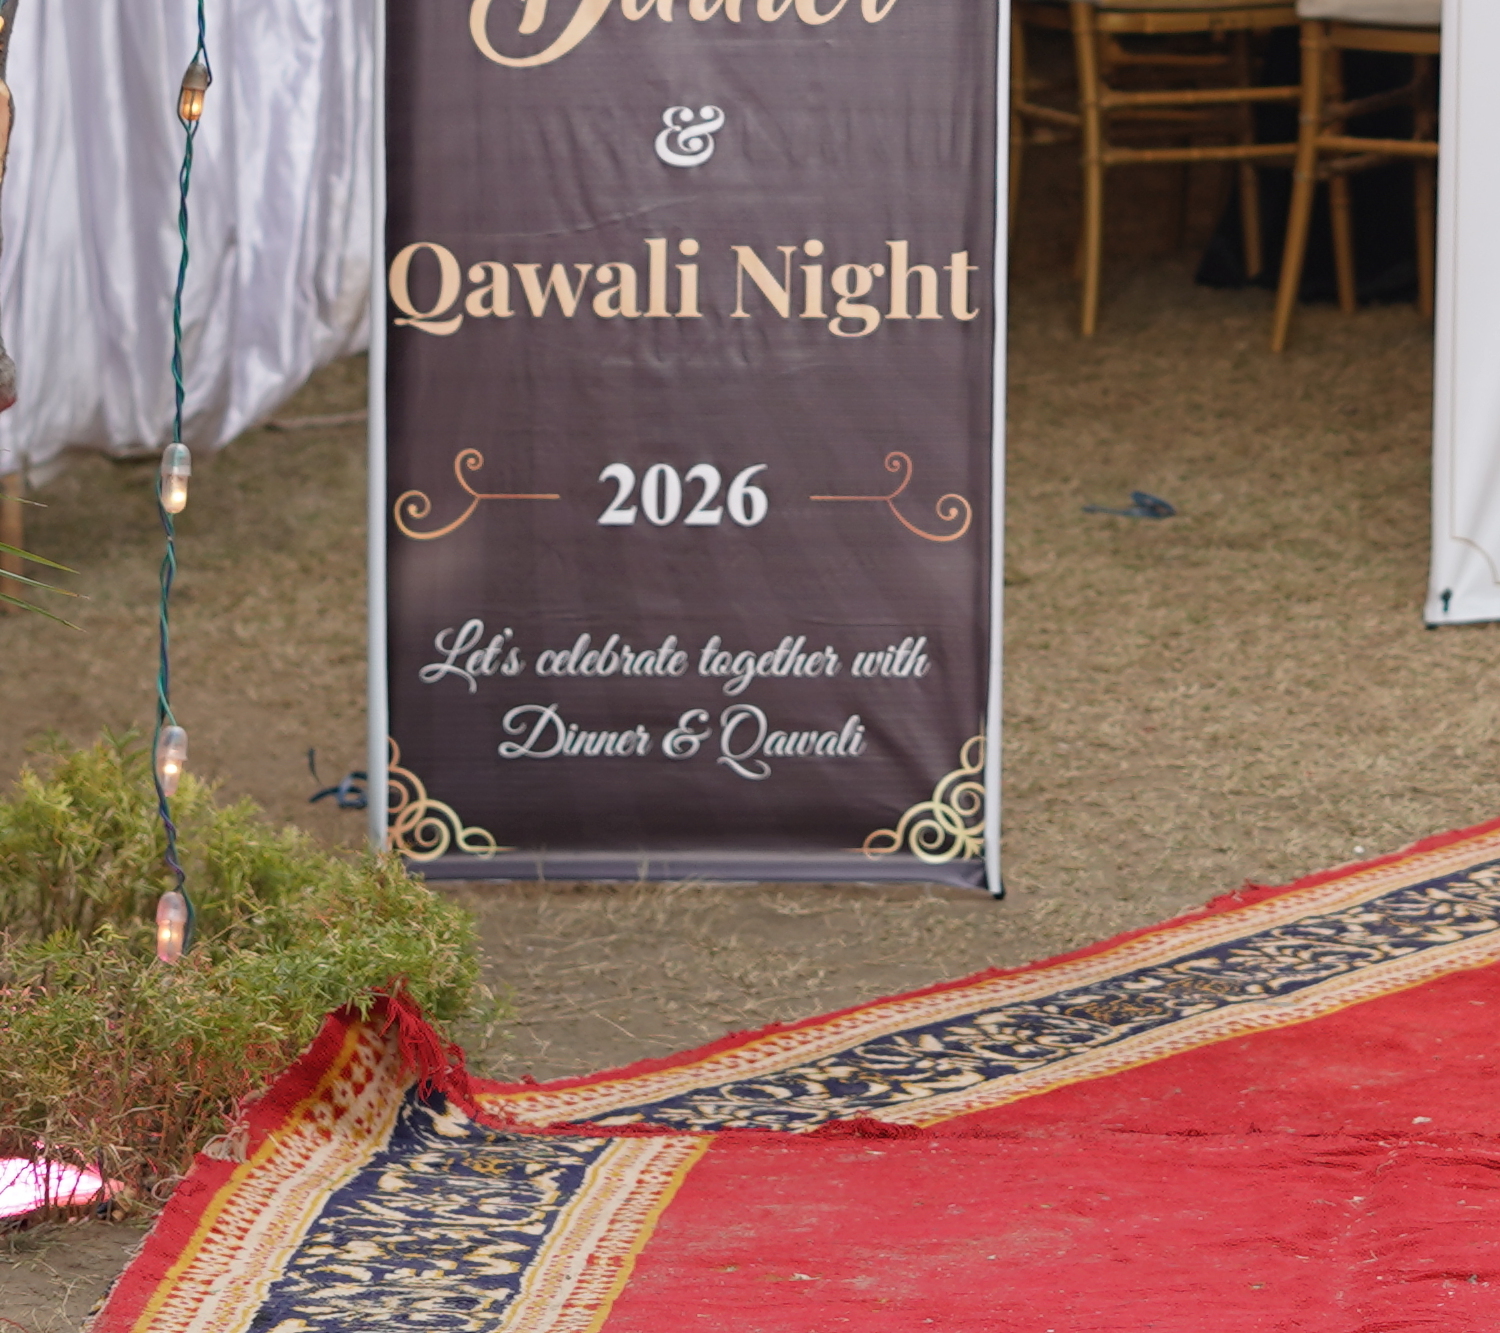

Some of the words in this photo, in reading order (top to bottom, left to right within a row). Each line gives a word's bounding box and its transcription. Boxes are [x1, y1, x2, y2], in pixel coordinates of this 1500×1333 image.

[654, 105, 725, 167] &
[389, 238, 702, 336] Qawali
[730, 239, 979, 337] Night
[598, 463, 769, 526] 2026
[418, 618, 520, 694] Let's
[536, 633, 688, 678] celebrate
[699, 634, 841, 697] together
[851, 636, 929, 678] with
[499, 703, 652, 759] Dinner
[662, 709, 709, 759] &
[717, 704, 866, 780] Qawali
